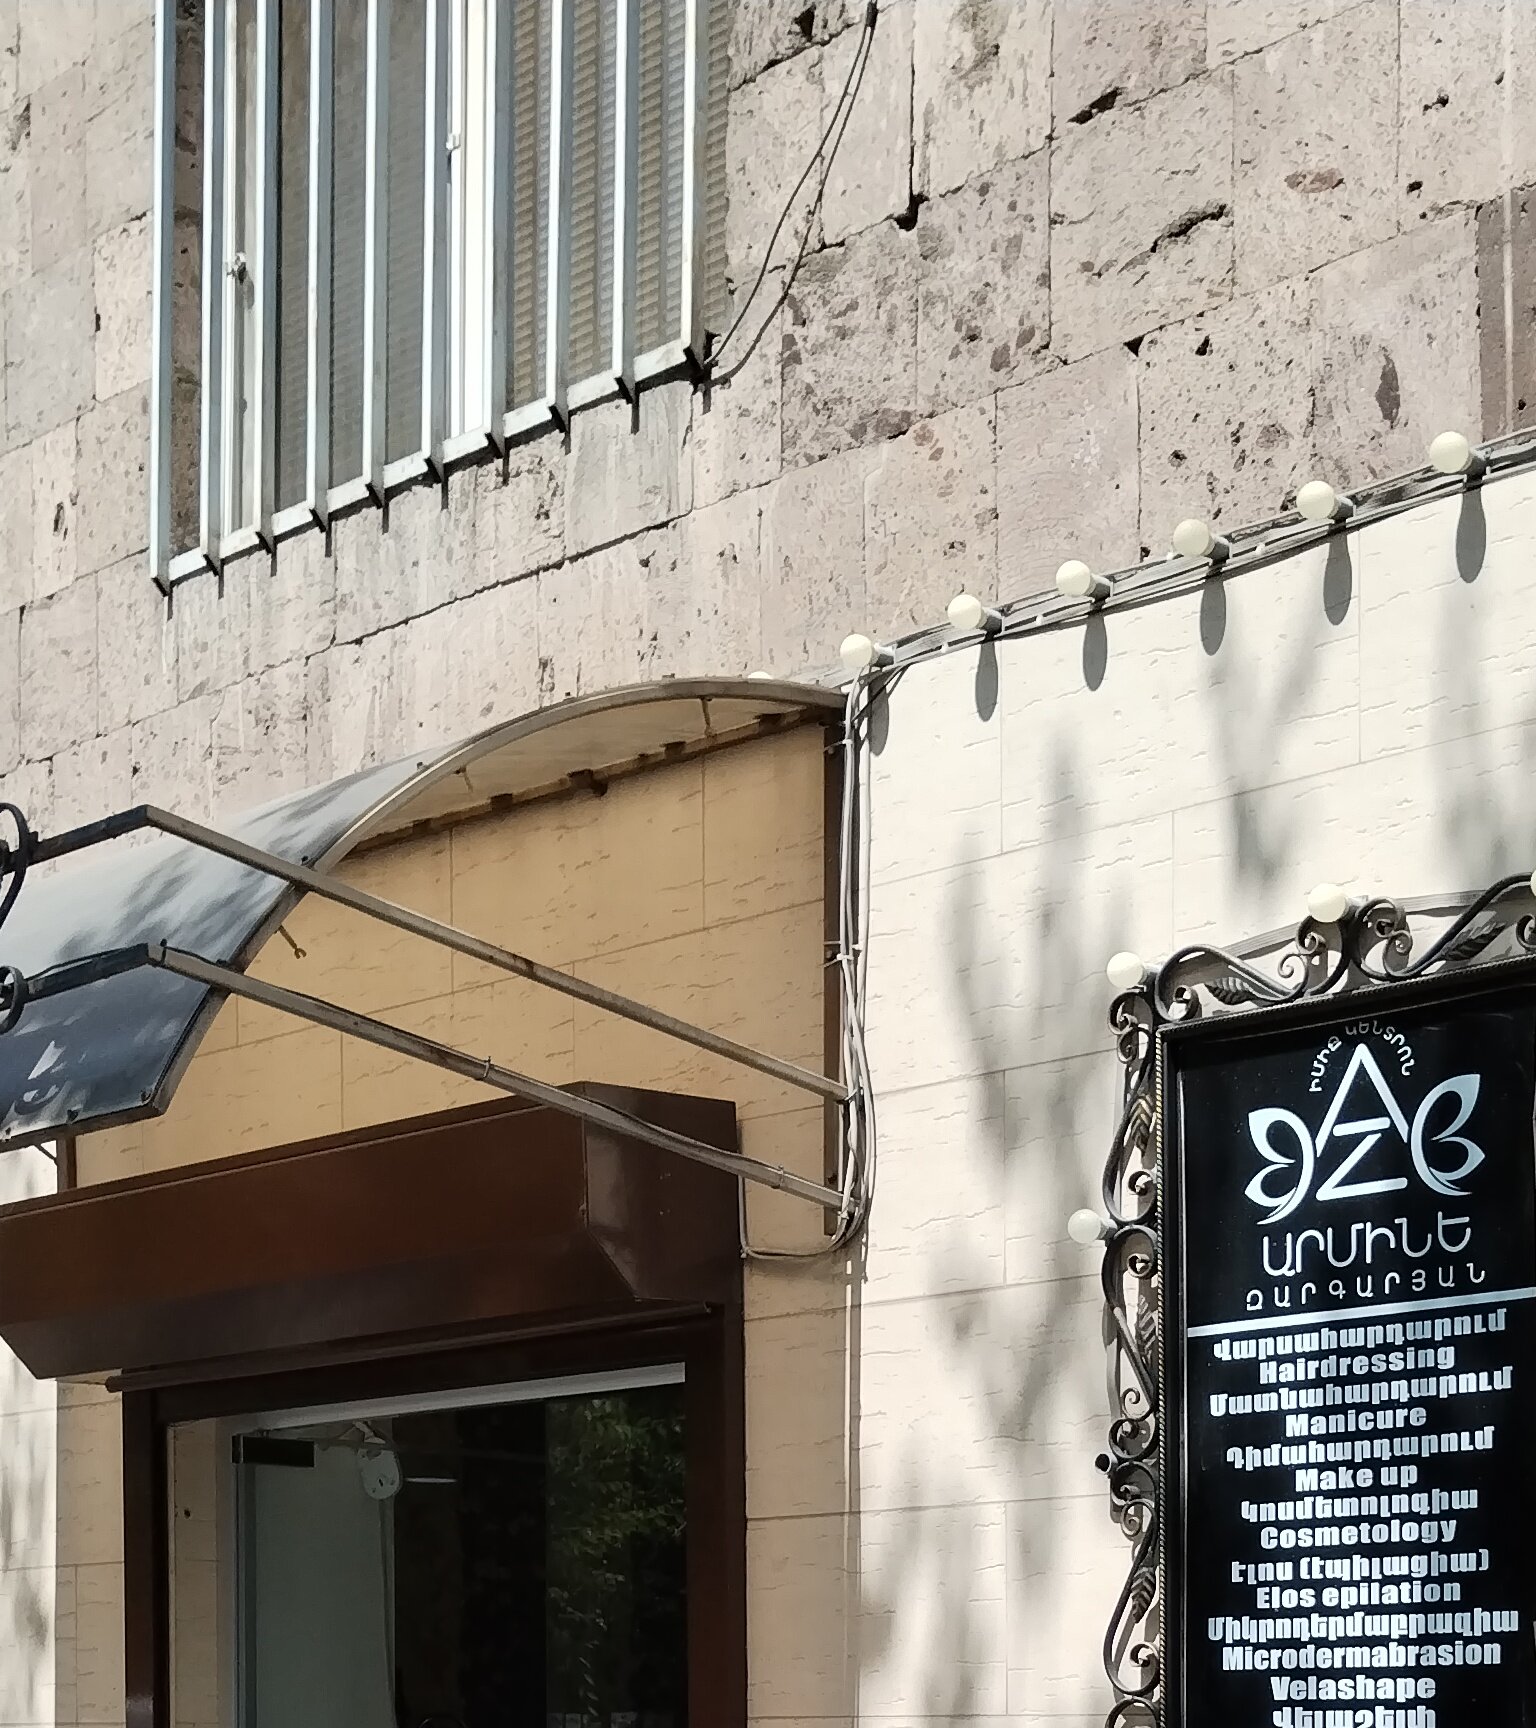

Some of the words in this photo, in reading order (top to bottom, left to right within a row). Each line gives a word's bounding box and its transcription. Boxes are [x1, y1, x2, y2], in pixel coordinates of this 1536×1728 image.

[1245, 1262, 1486, 1312] ԶԱՐԳԱՐՅԱՆ
[1214, 1308, 1507, 1361] Վարսահարդարում
[1259, 1345, 1455, 1385] Hairdressing
[1210, 1366, 1513, 1417] Մատնահարդարում
[1285, 1404, 1426, 1437] Manicure
[1226, 1426, 1495, 1472] Դիմահարդարում
[1295, 1467, 1373, 1493] Make
[1381, 1464, 1418, 1488] up
[1241, 1488, 1478, 1523] Կոսմետոլոգիա
[1260, 1519, 1457, 1550] Cosmetology
[1231, 1560, 1293, 1585] Էլոս
[1256, 1585, 1315, 1609] Elos
[1321, 1580, 1461, 1610] epilation
[1222, 1640, 1501, 1671] Microdermabrasion
[1270, 1675, 1436, 1702] Velashape
